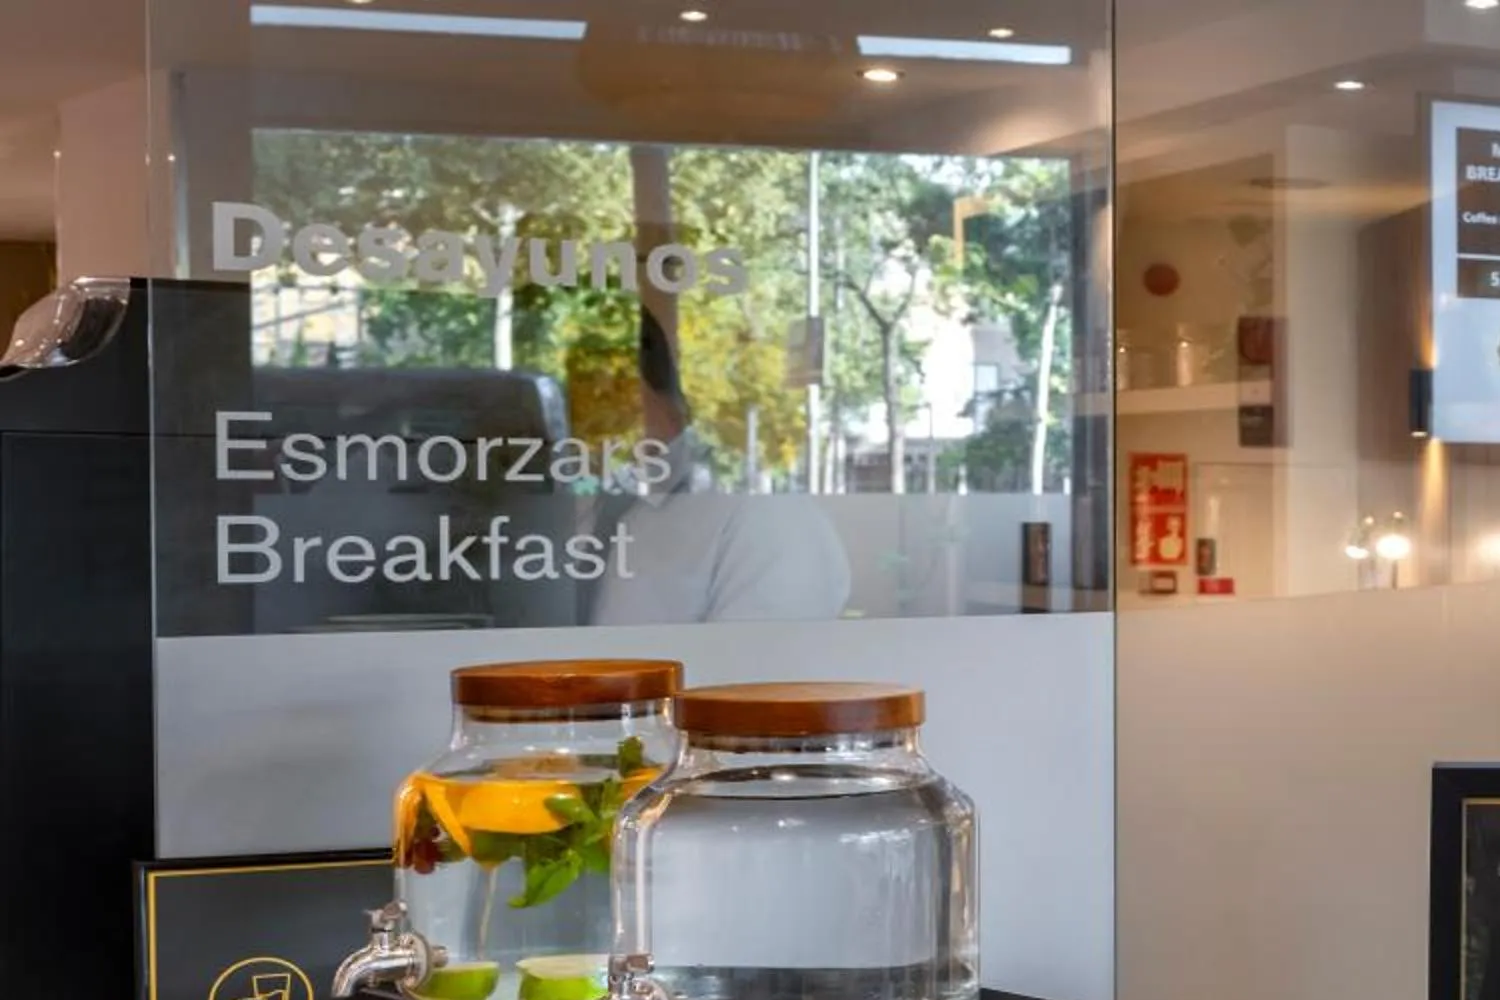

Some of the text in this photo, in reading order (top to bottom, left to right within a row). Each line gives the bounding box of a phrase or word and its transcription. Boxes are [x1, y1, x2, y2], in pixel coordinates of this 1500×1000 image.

[212, 202, 751, 299] Desayunos
[214, 410, 672, 484] Esmorzars
[216, 515, 635, 583] Breakfast
